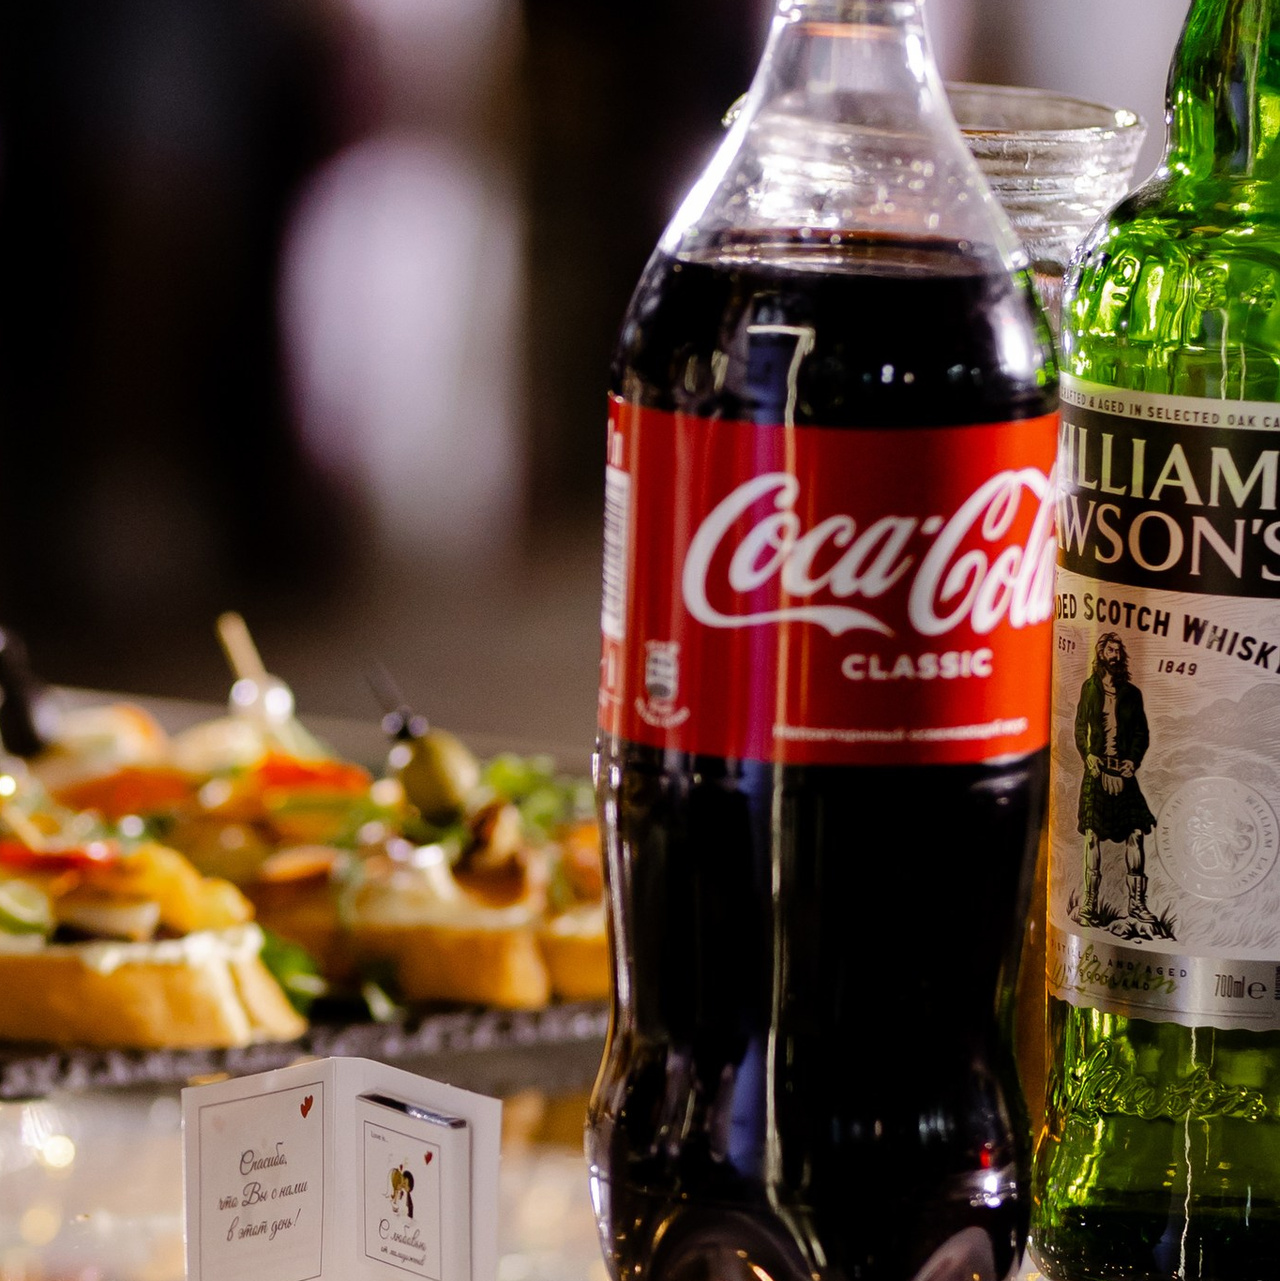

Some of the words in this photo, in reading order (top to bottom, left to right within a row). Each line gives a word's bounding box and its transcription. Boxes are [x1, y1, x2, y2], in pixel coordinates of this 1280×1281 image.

[1098, 398, 1125, 414] AGED
[1130, 404, 1142, 417] IN
[1147, 407, 1220, 425] SELECTED
[1227, 414, 1256, 428] OAK
[1083, 592, 1171, 637] SCOTCH
[1183, 614, 1280, 675] WHISK
[841, 648, 994, 680] CLASSIC
[1157, 659, 1198, 676] 1849
[1107, 958, 1134, 971] AND
[1145, 965, 1187, 978] AGED
[1214, 973, 1246, 999] 700ml
[242, 1181, 267, 1207] Вы
[279, 1181, 308, 1197] нами
[226, 1216, 239, 1241] в
[238, 1221, 267, 1239] этот
